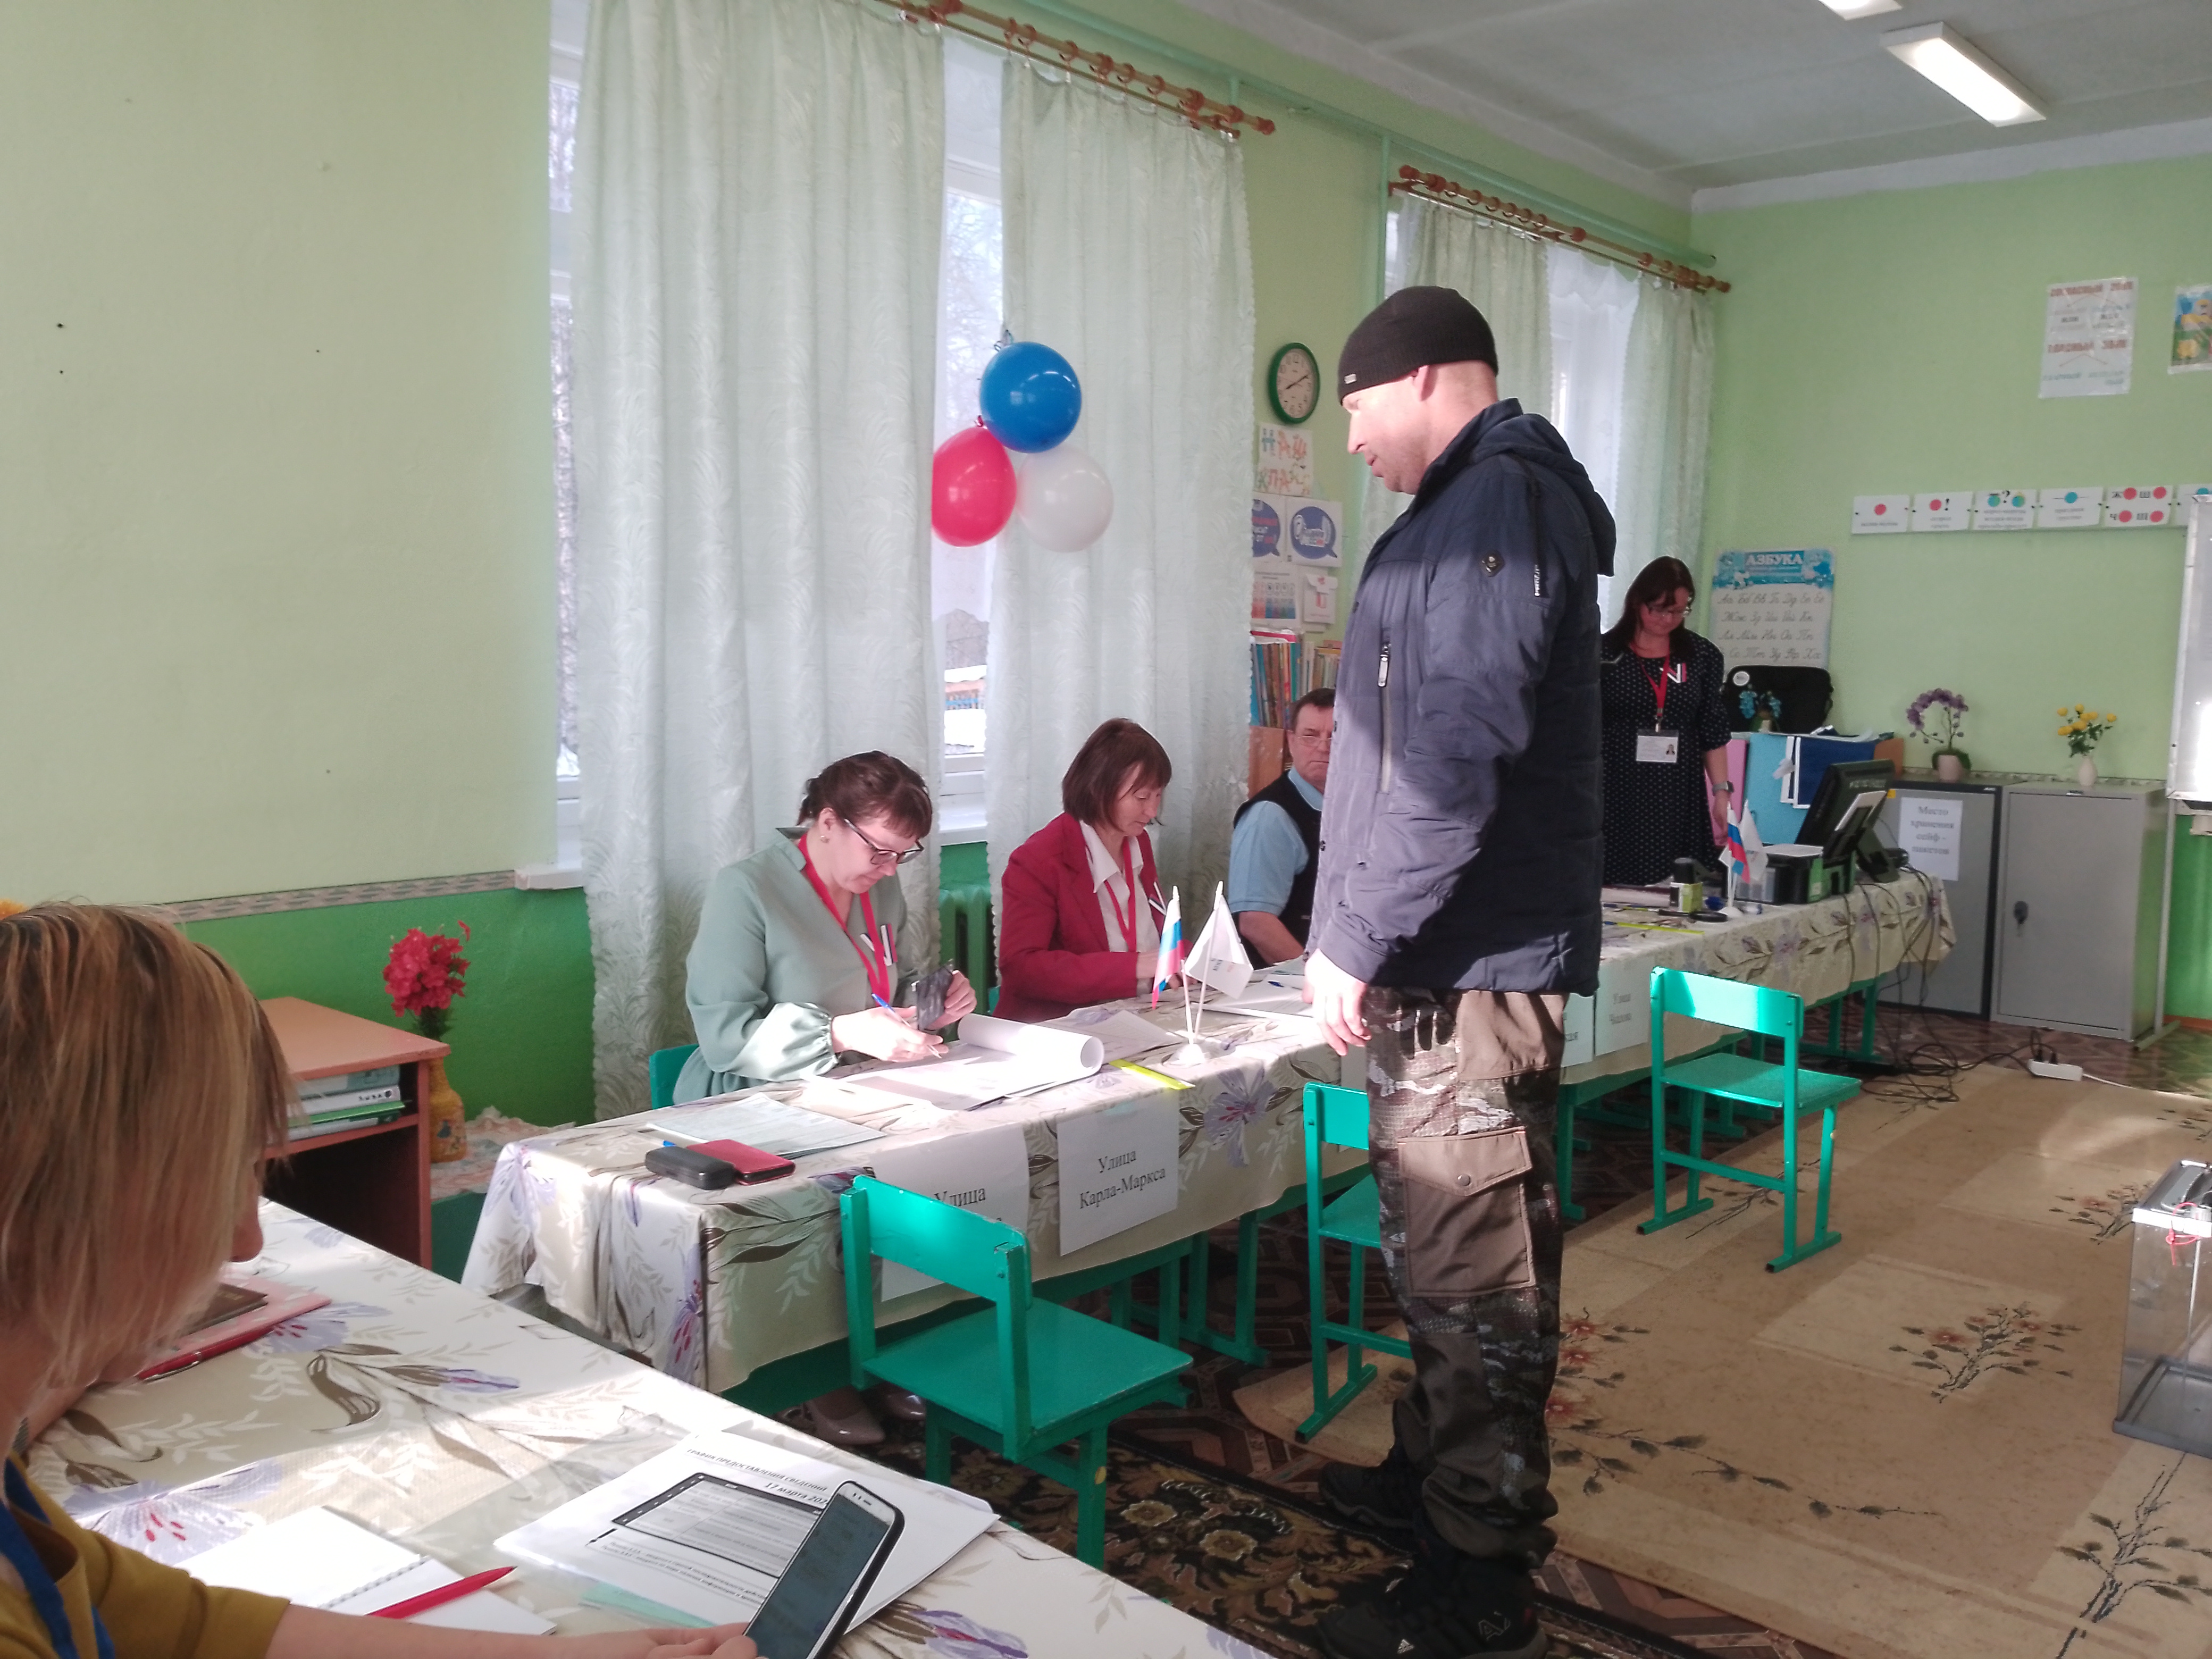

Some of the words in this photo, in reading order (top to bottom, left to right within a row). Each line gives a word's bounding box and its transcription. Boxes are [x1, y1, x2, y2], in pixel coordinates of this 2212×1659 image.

[1745, 553, 1803, 566] АЗБУКА
[1918, 806, 1948, 816] Место
[1098, 1151, 1136, 1174] Улица
[1079, 1168, 1166, 1209] Карла-Маркса
[934, 1188, 986, 1207] Улица
[778, 1487, 808, 1499] марта
